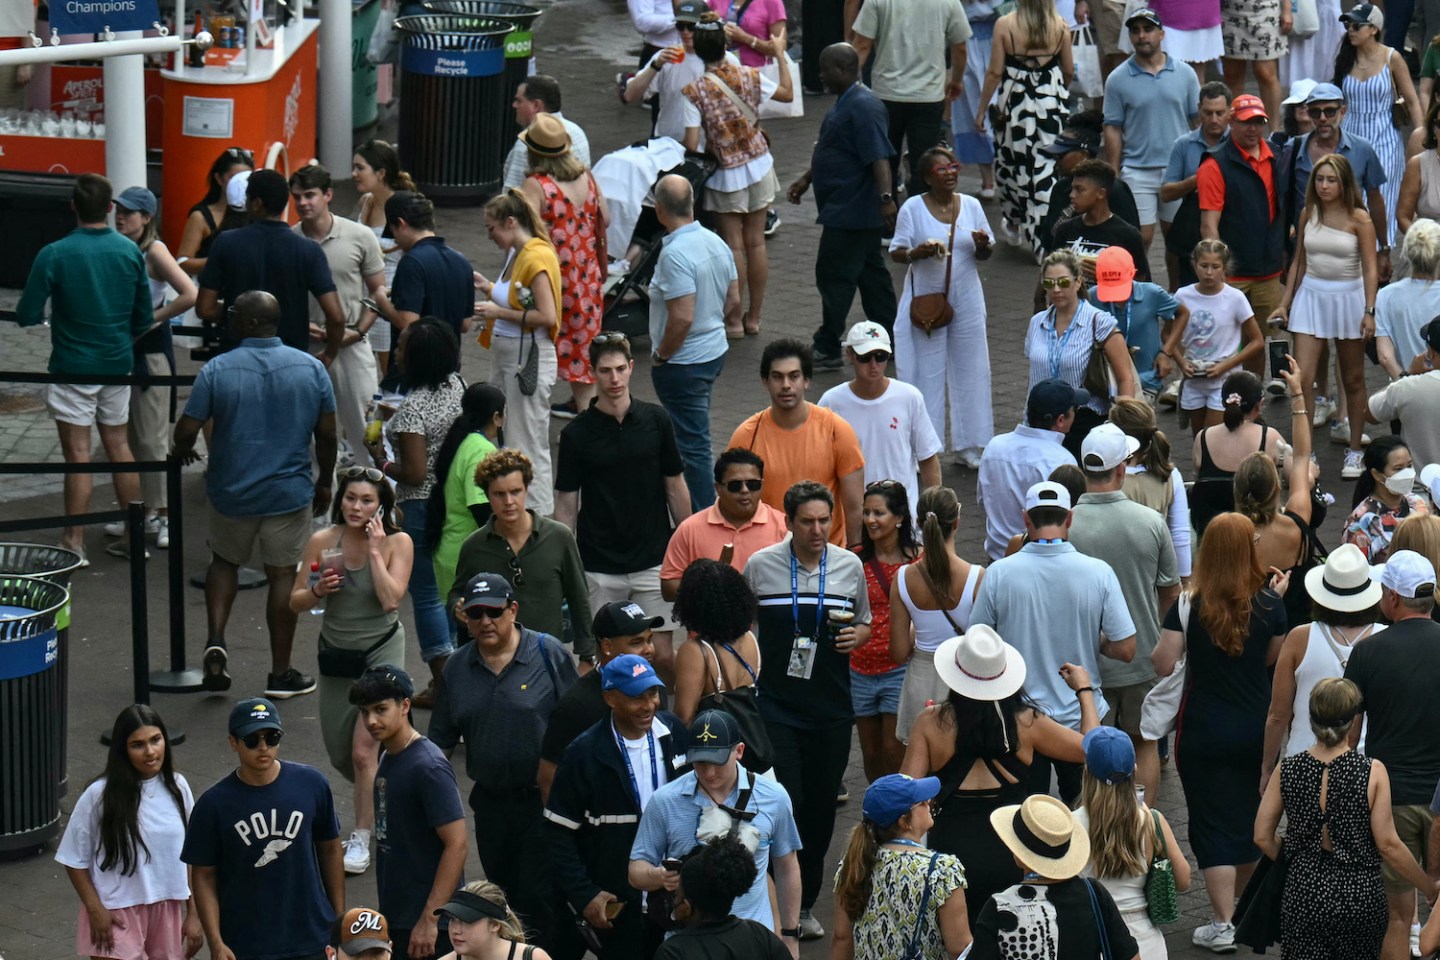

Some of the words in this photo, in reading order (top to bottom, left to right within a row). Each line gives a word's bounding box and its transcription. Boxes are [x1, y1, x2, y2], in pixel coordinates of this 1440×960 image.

[65, 0, 137, 15] Champions
[436, 57, 467, 68] Please
[434, 65, 469, 76] Recycle
[234, 808, 304, 847] POLO
[350, 911, 383, 935] M
